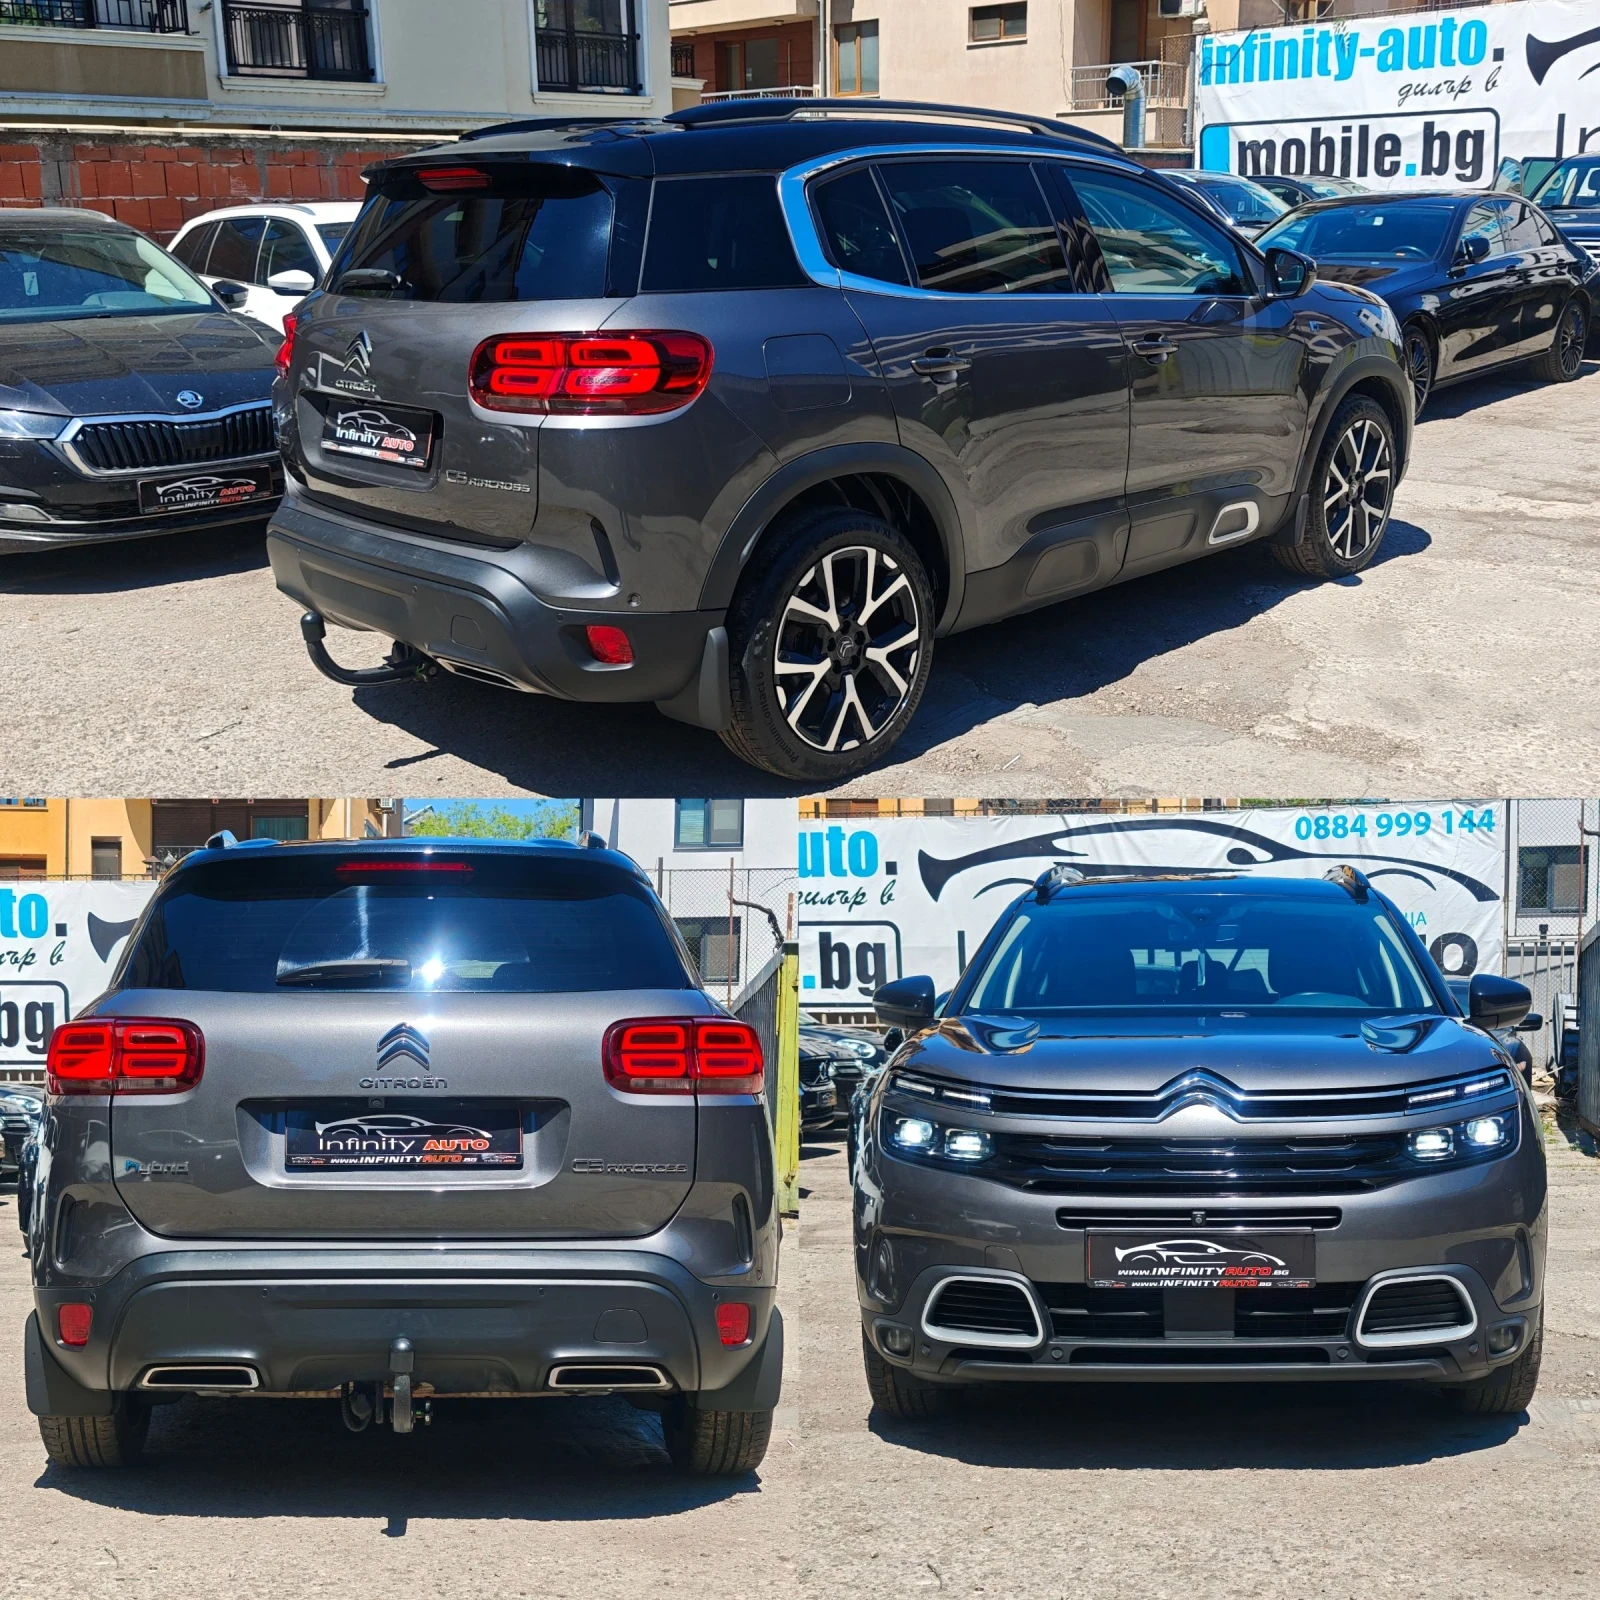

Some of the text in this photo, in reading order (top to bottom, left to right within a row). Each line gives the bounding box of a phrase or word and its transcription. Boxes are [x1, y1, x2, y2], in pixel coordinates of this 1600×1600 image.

[1237, 121, 1486, 183] mobile.bg
[335, 426, 381, 447] Infinity
[381, 436, 415, 452] AUTO
[446, 469, 531, 493] C5 AIRCROSS
[159, 489, 216, 504] Infinity
[219, 484, 257, 497] AUTO
[1294, 808, 1496, 841] 0884 999 144
[319, 1137, 490, 1153] Infinity AUTO
[572, 1158, 688, 1174] C5 AIRCROSS
[1117, 1266, 1290, 1276] www.INFINITYAUTO.BG
[1131, 1279, 1273, 1288] www.INFINITYAUTO.BG
